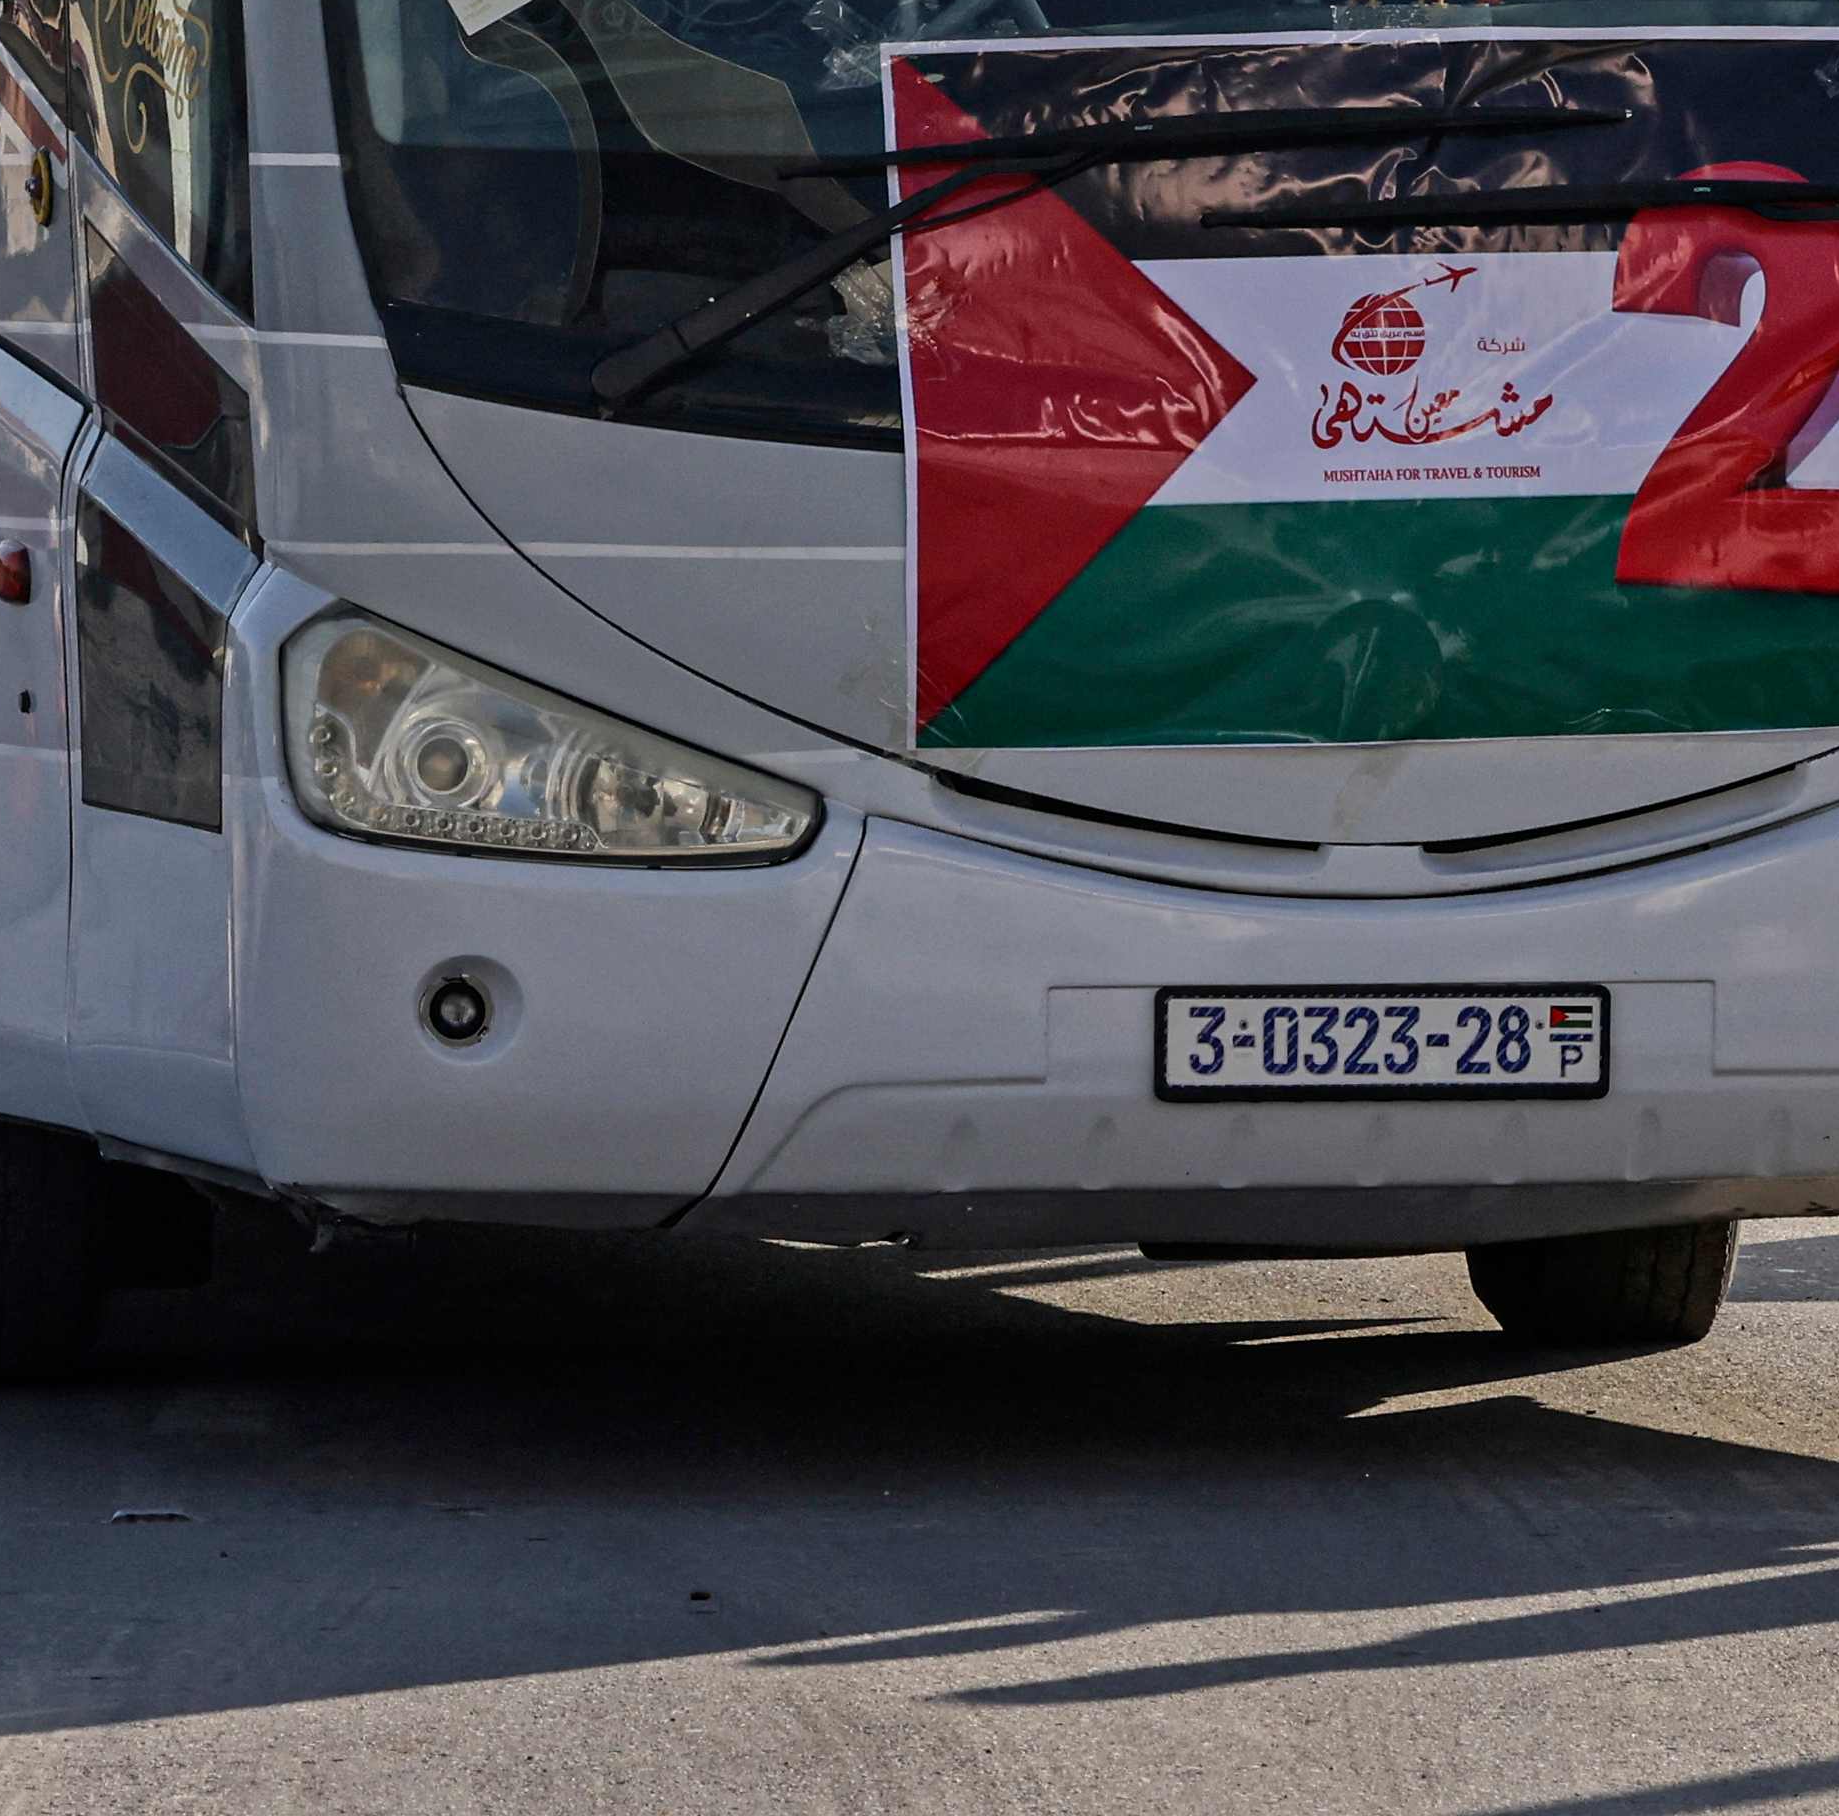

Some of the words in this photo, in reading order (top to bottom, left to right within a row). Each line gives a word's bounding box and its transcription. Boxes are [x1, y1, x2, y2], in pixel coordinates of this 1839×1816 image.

[1477, 336, 1526, 355] شركة
[1323, 468, 1393, 483] MUSHTAHA
[1396, 468, 1421, 482] FOR
[1424, 467, 1471, 481] TRAVEL
[1473, 467, 1483, 480] &
[1486, 465, 1541, 480] TOURISM
[1188, 1004, 1532, 1075] 3-0323-28
